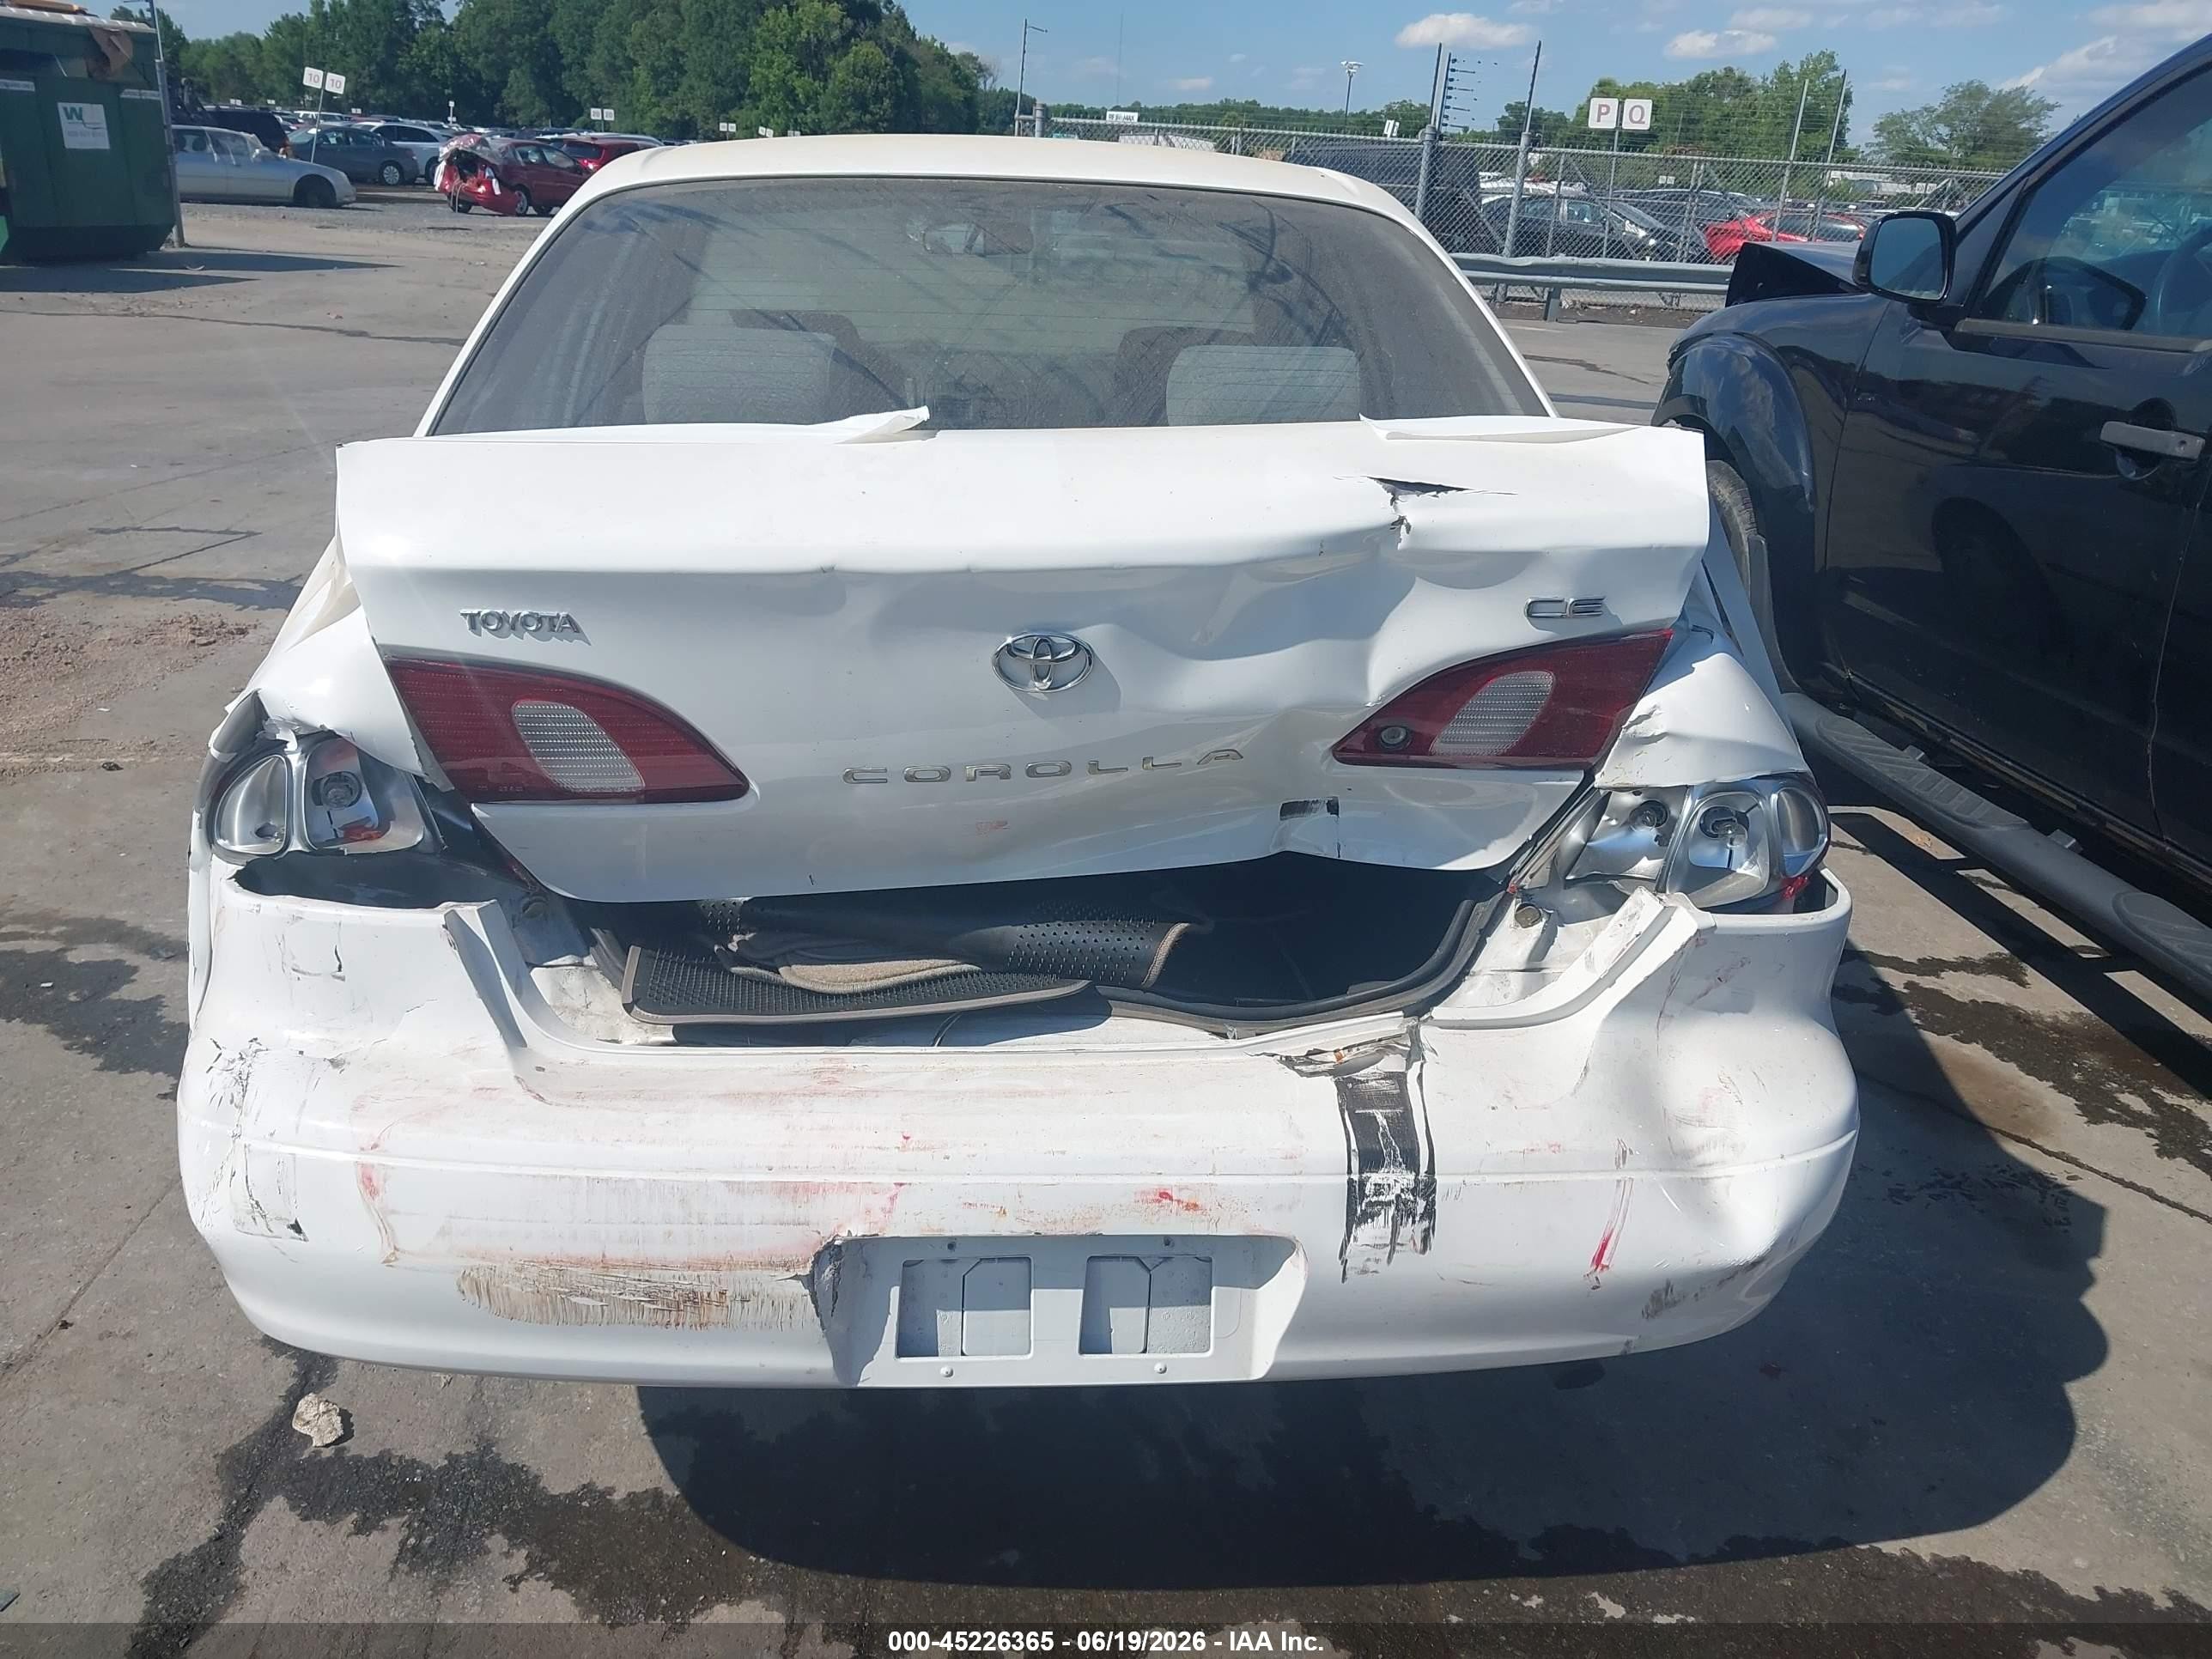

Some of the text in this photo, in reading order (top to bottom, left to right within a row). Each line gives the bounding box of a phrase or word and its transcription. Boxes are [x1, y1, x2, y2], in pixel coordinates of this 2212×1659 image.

[308, 73, 319, 84] 10
[330, 78, 342, 89] 10
[1596, 103, 1611, 123] P
[1628, 104, 1646, 125] Q
[1524, 598, 1606, 618] CE
[459, 610, 580, 633] TOYOTA
[842, 748, 1244, 785] COROLLA
